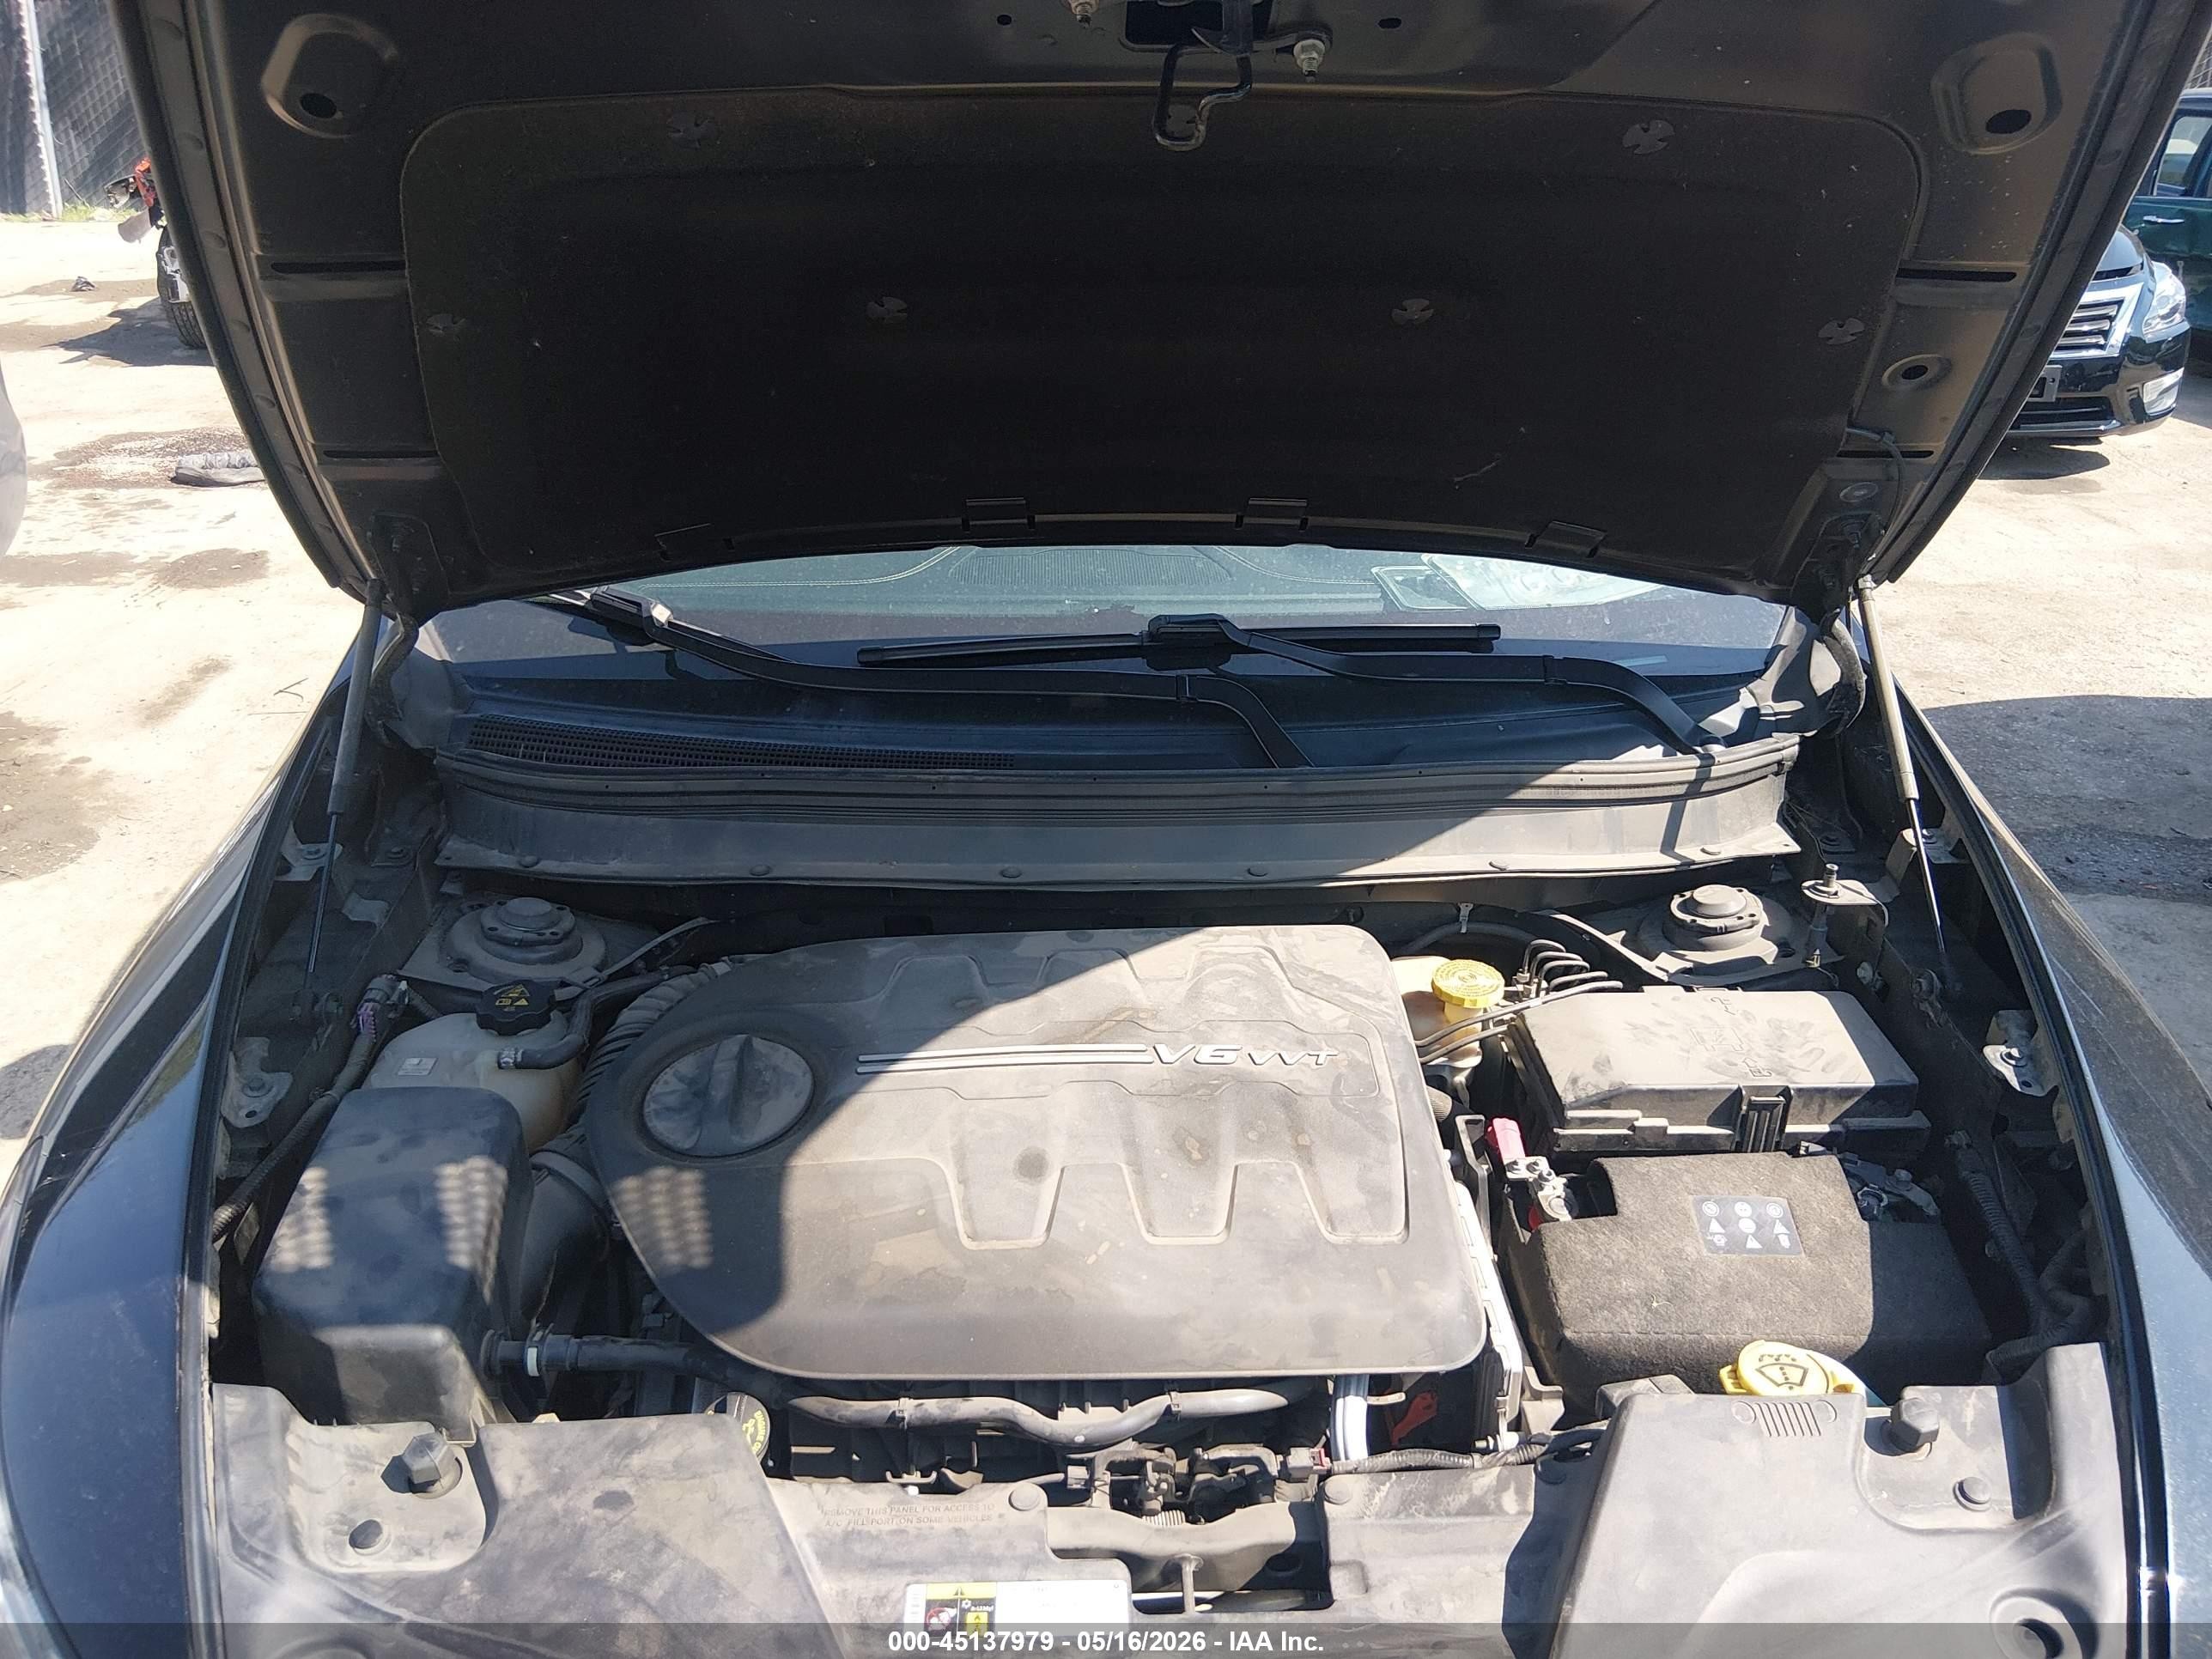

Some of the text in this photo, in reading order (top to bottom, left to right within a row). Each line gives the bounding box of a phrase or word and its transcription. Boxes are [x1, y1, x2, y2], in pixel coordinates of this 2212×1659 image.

[1152, 1043, 1340, 1066] V6 VVT
[890, 1505, 920, 1514] PANEL
[922, 1504, 941, 1513] FOR
[943, 1504, 981, 1512] ACCESS
[871, 1517, 896, 1526] PORT
[899, 1516, 915, 1525] ON
[916, 1515, 942, 1524] SOME
